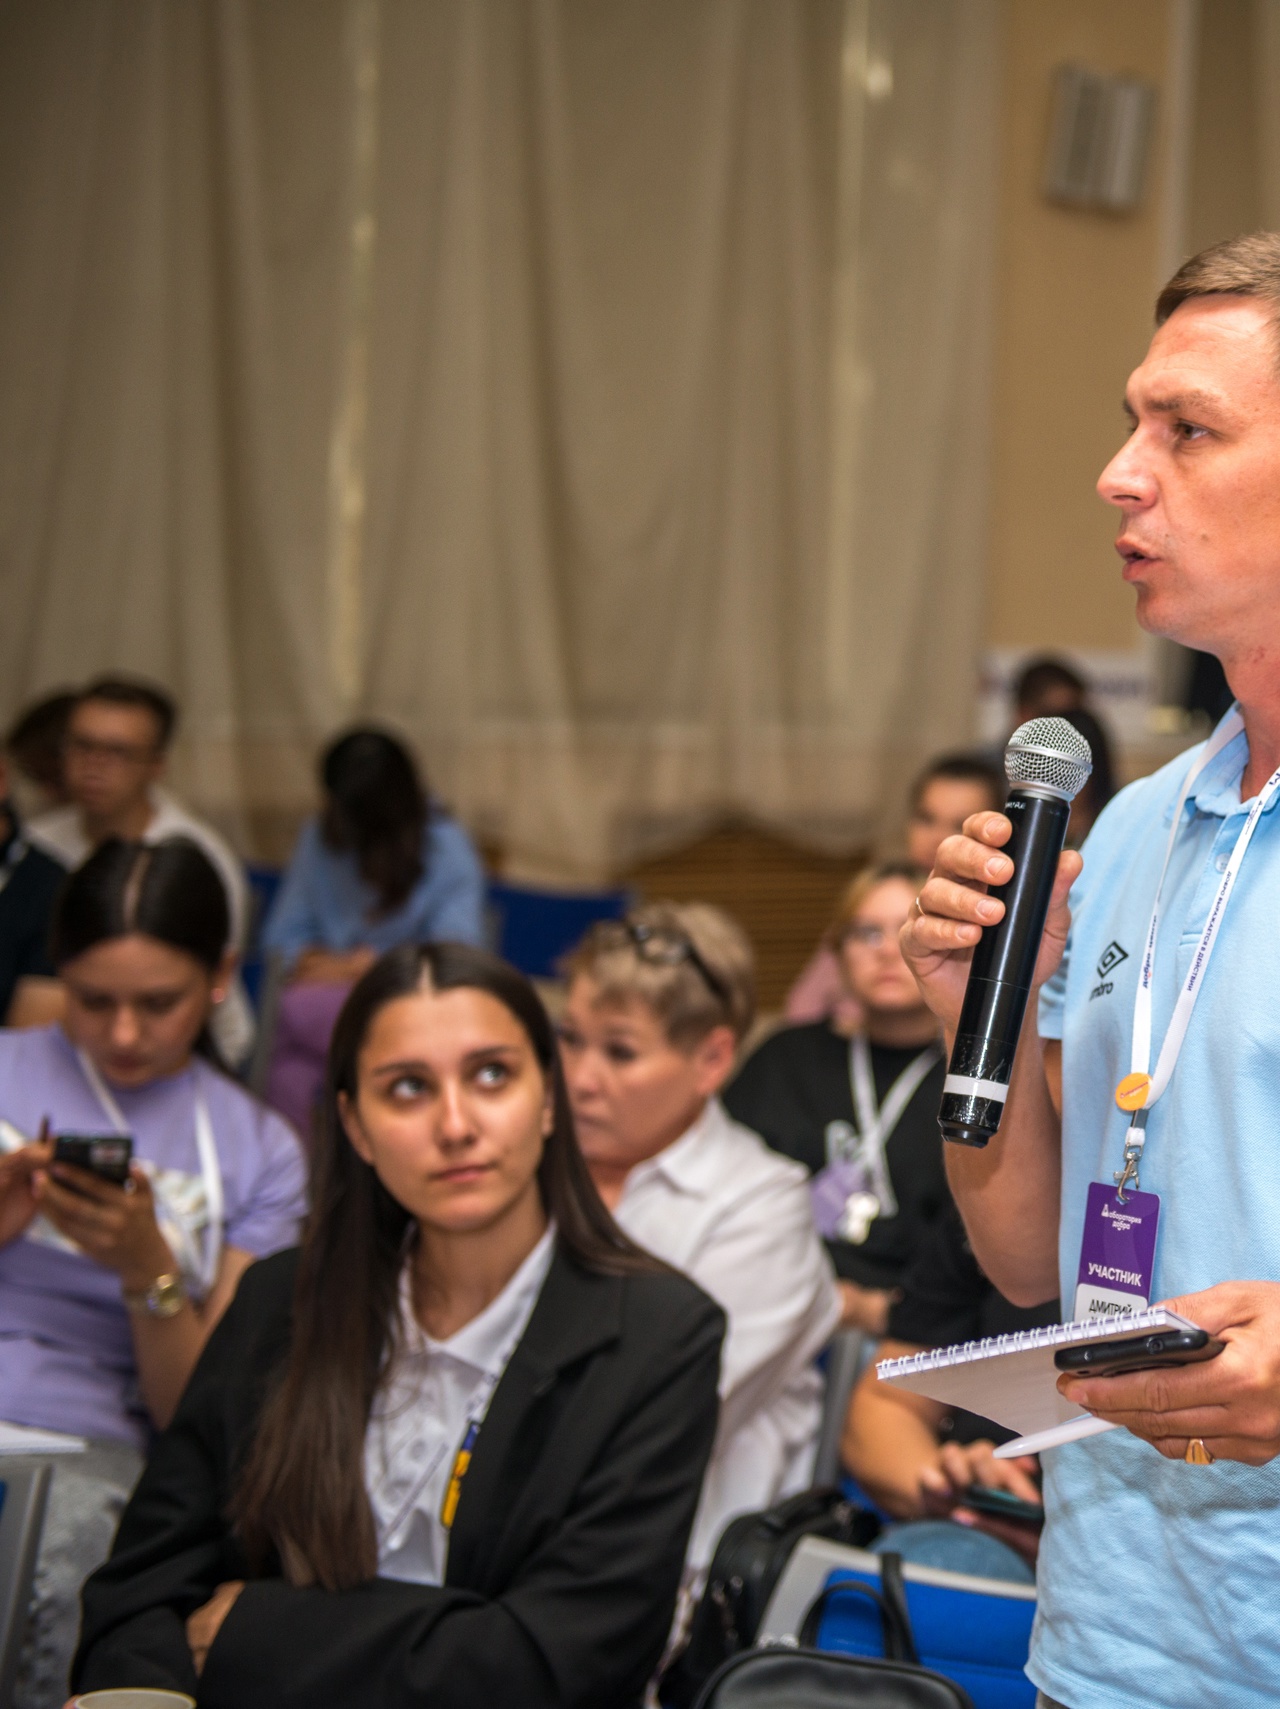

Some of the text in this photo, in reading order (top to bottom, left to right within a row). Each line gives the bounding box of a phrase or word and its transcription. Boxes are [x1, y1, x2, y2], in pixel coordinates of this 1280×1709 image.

[1220, 871, 1232, 896] ДОБРО
[1203, 897, 1223, 946] ВЫРАЖАЕТСЯ
[1186, 951, 1204, 991] ДЕЙСТВИИ
[1088, 1262, 1142, 1287] УЧАСТНИК
[1089, 1299, 1132, 1316] ДМИТРИЙ
